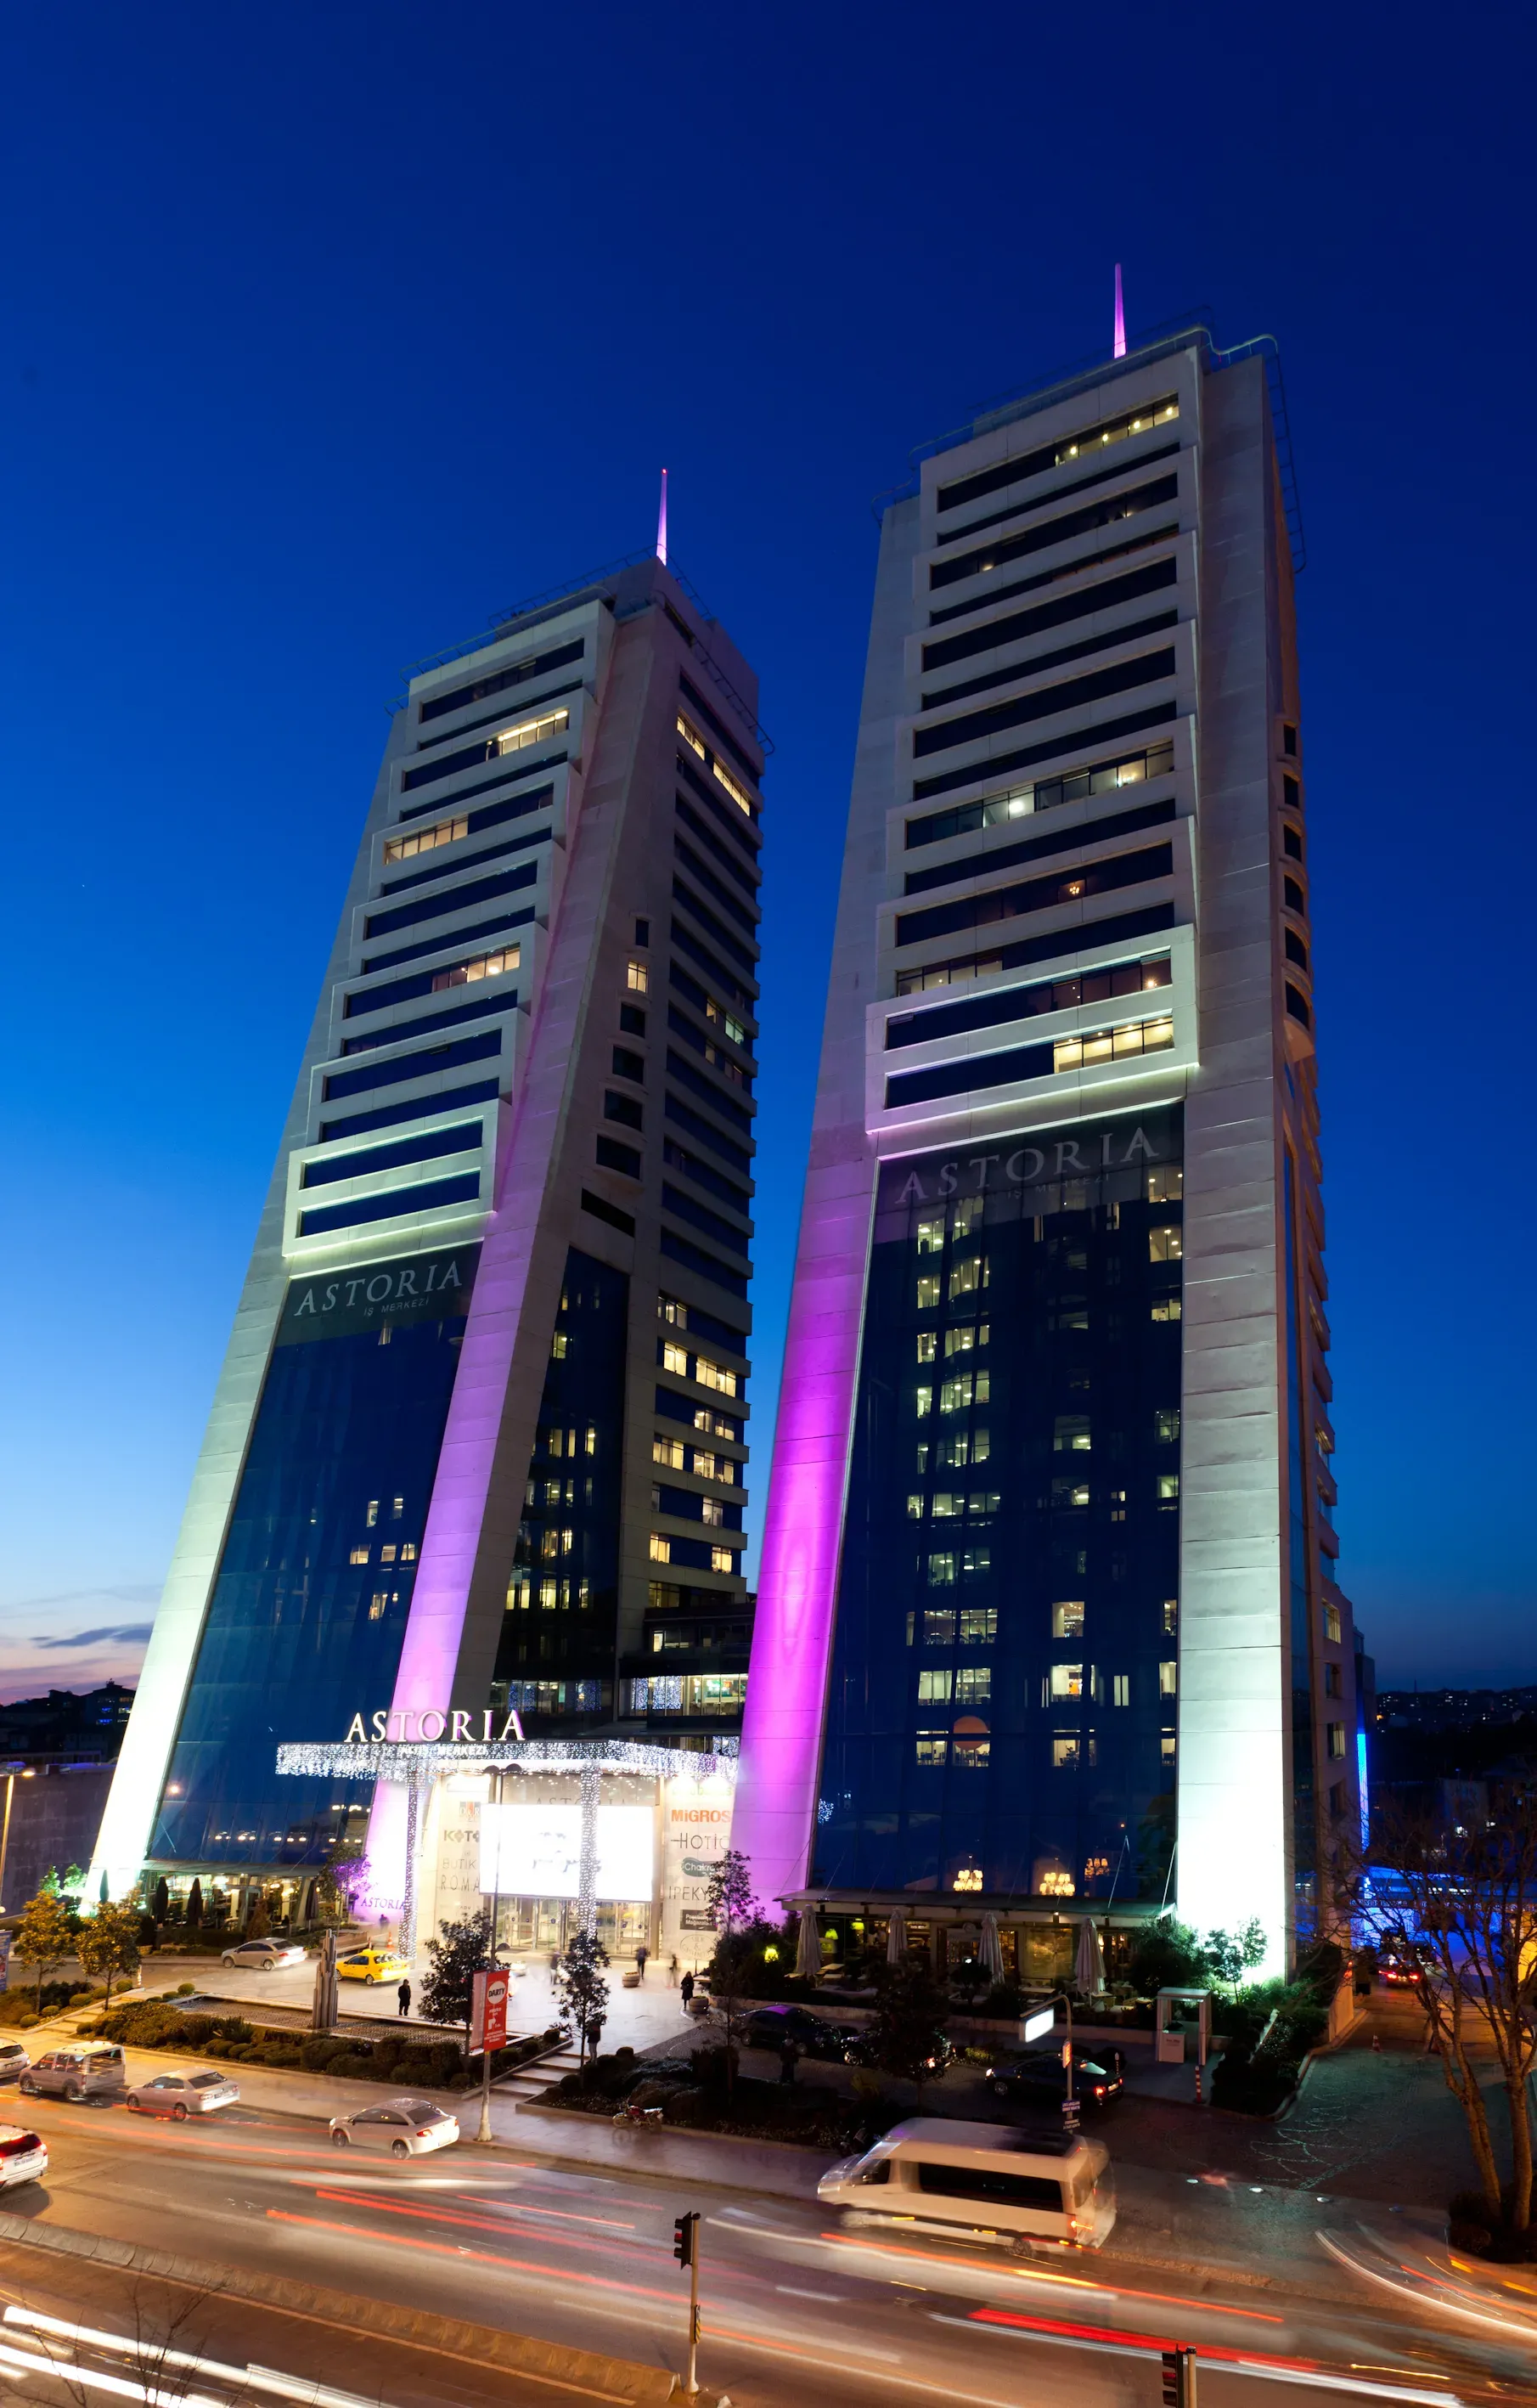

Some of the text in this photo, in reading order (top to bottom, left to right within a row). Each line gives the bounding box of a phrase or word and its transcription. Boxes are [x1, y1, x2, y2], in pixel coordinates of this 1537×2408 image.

[894, 1126, 1161, 1204] ASTORIA
[294, 1260, 463, 1317] ASTORIA
[343, 1709, 526, 1743] ASTORIA
[360, 1897, 405, 1910] ASTORIA
[488, 1988, 505, 1998] DARTY
